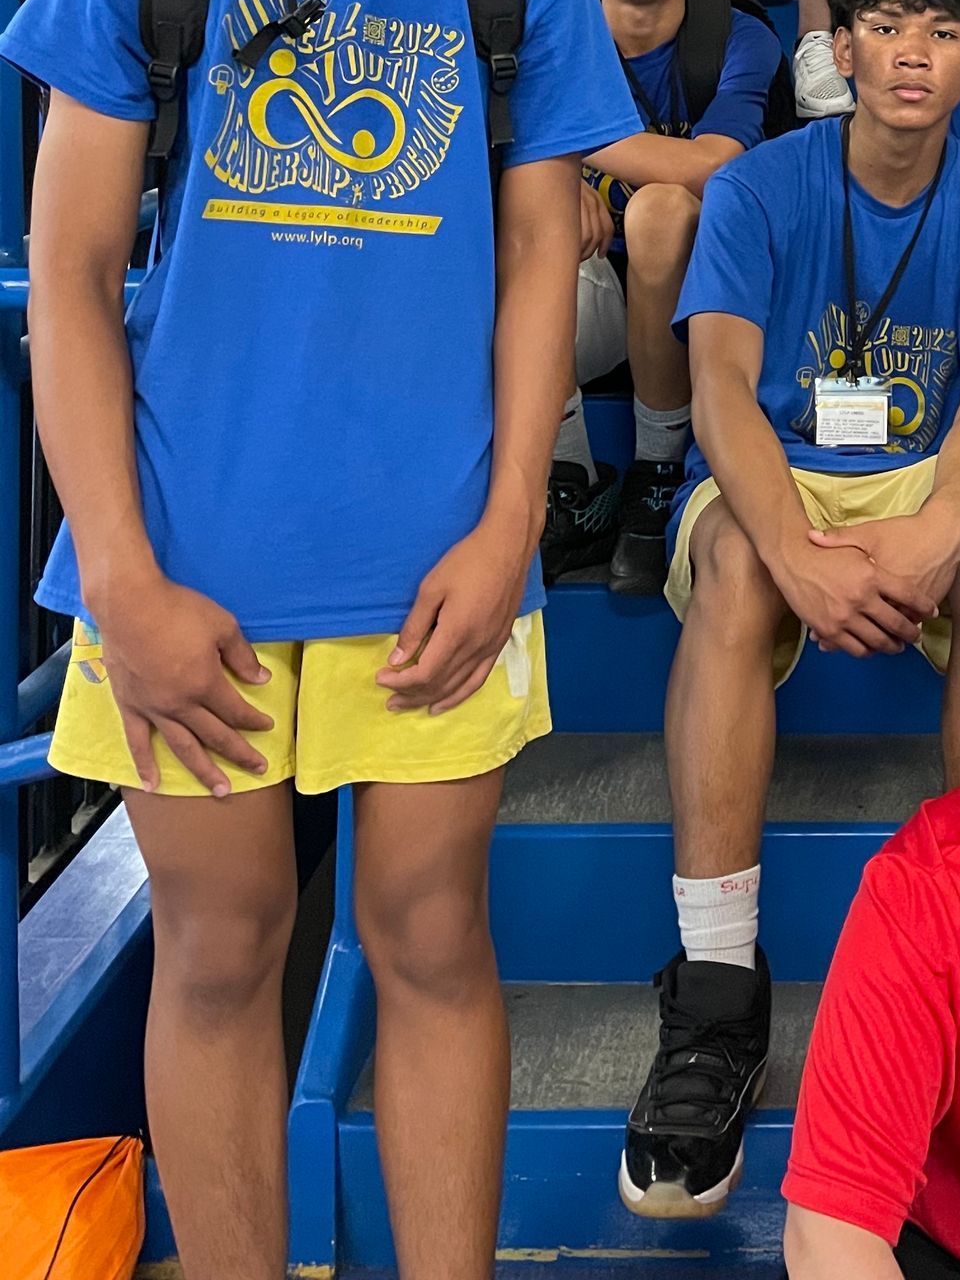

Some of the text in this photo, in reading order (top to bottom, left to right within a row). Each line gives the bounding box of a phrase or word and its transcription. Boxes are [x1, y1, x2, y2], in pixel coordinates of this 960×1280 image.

[388, 20, 465, 67] 2022
[300, 40, 418, 108] YOUTH
[204, 89, 351, 198] LEADERSHIP
[371, 79, 465, 200] PROGRAM
[208, 203, 266, 218] Building
[272, 209, 280, 217] a
[287, 209, 330, 221] Legacy
[336, 211, 350, 221] of
[271, 230, 364, 249] www.lylp.org
